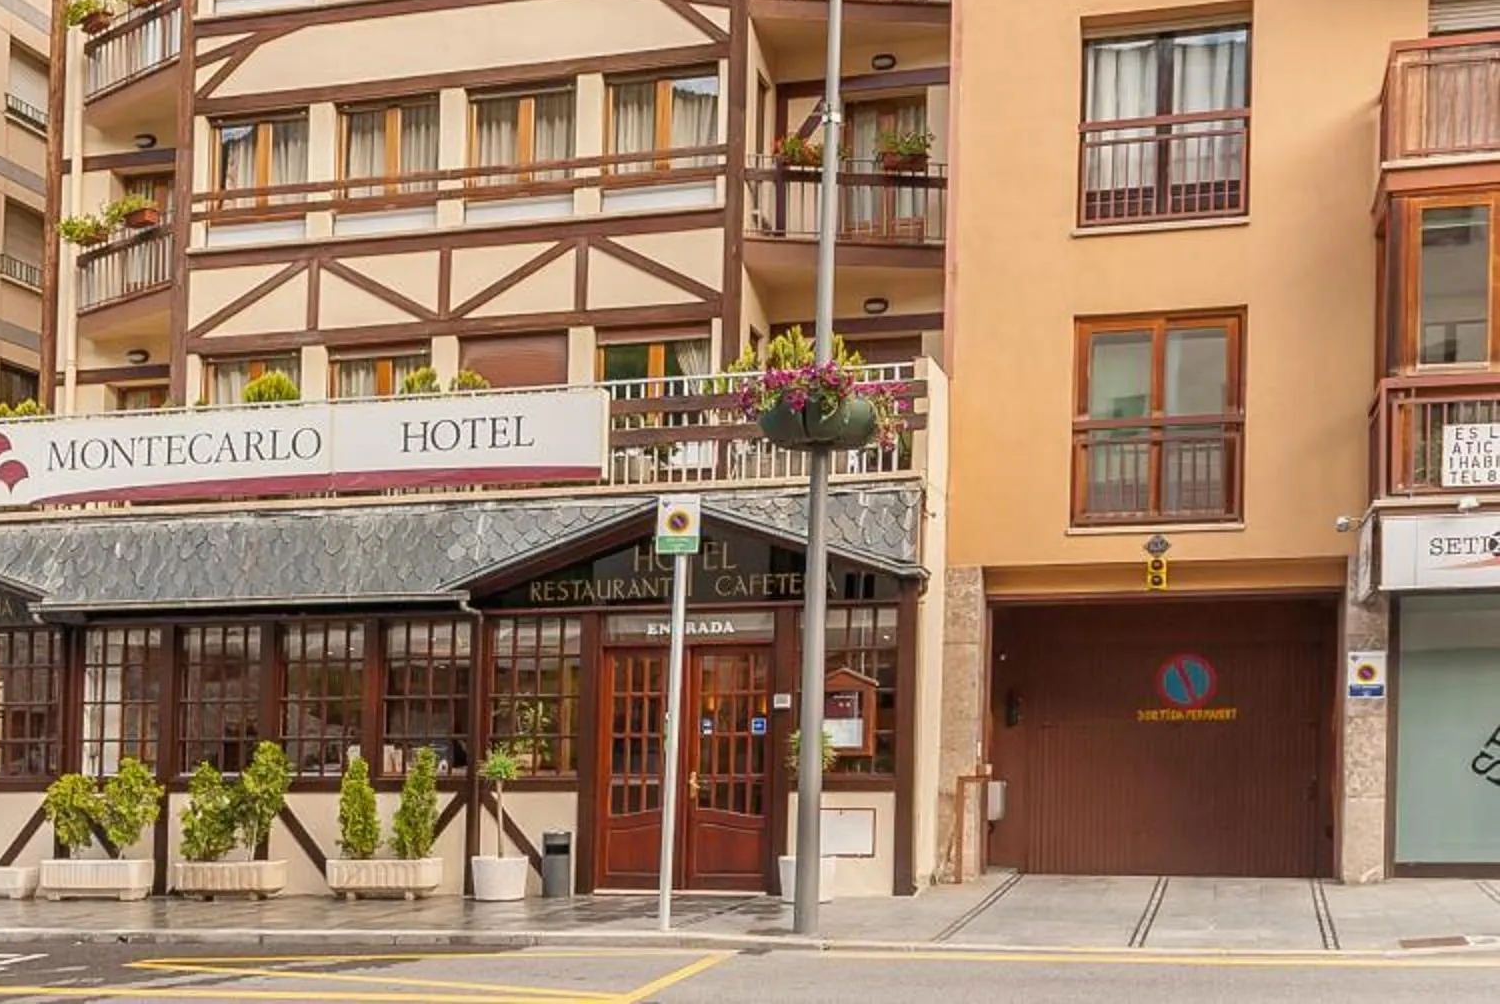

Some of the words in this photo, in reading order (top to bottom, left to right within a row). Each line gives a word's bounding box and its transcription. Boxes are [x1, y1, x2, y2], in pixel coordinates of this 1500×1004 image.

[400, 415, 535, 453] HOTEL
[1455, 427, 1479, 441] ES
[47, 427, 322, 471] MONTECARLO
[1451, 441, 1493, 454] ATIC
[1449, 470, 1481, 484] TEL
[633, 541, 738, 573] HEL
[531, 578, 673, 602] RESTAURANT
[715, 570, 837, 597] CAFETEA
[647, 621, 734, 635] ENRADA
